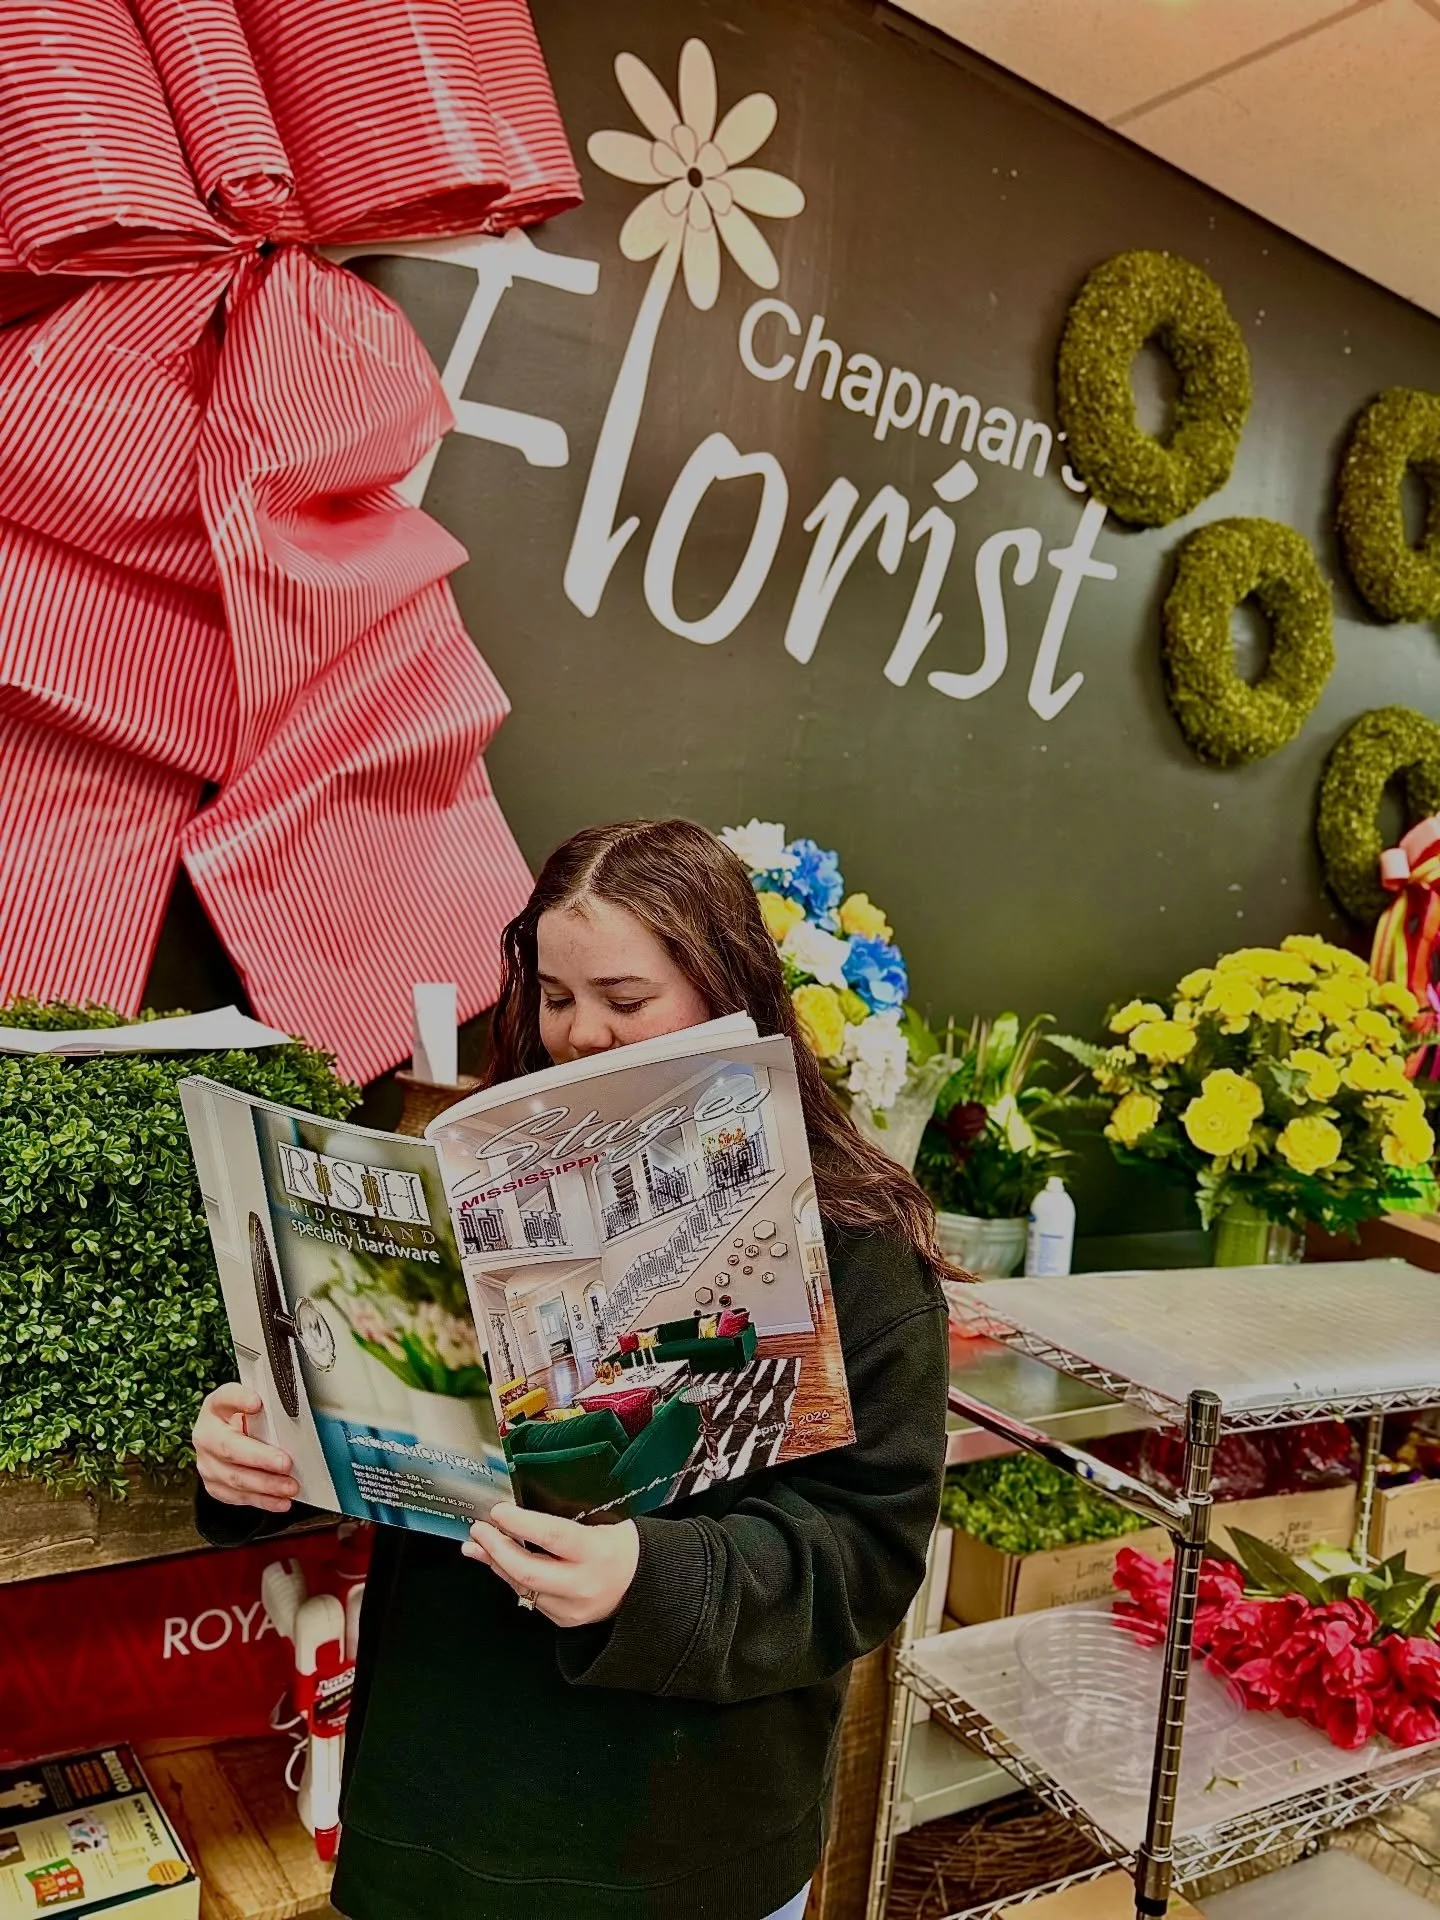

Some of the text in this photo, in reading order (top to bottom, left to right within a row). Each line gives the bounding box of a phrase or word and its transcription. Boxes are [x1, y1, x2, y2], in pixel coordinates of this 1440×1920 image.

[322, 226, 1118, 721] Florist
[452, 1087, 770, 1199] Stages
[288, 1199, 436, 1245] RIDGELAND
[292, 1219, 441, 1263] specialty hardware
[798, 1409, 830, 1424] 2026
